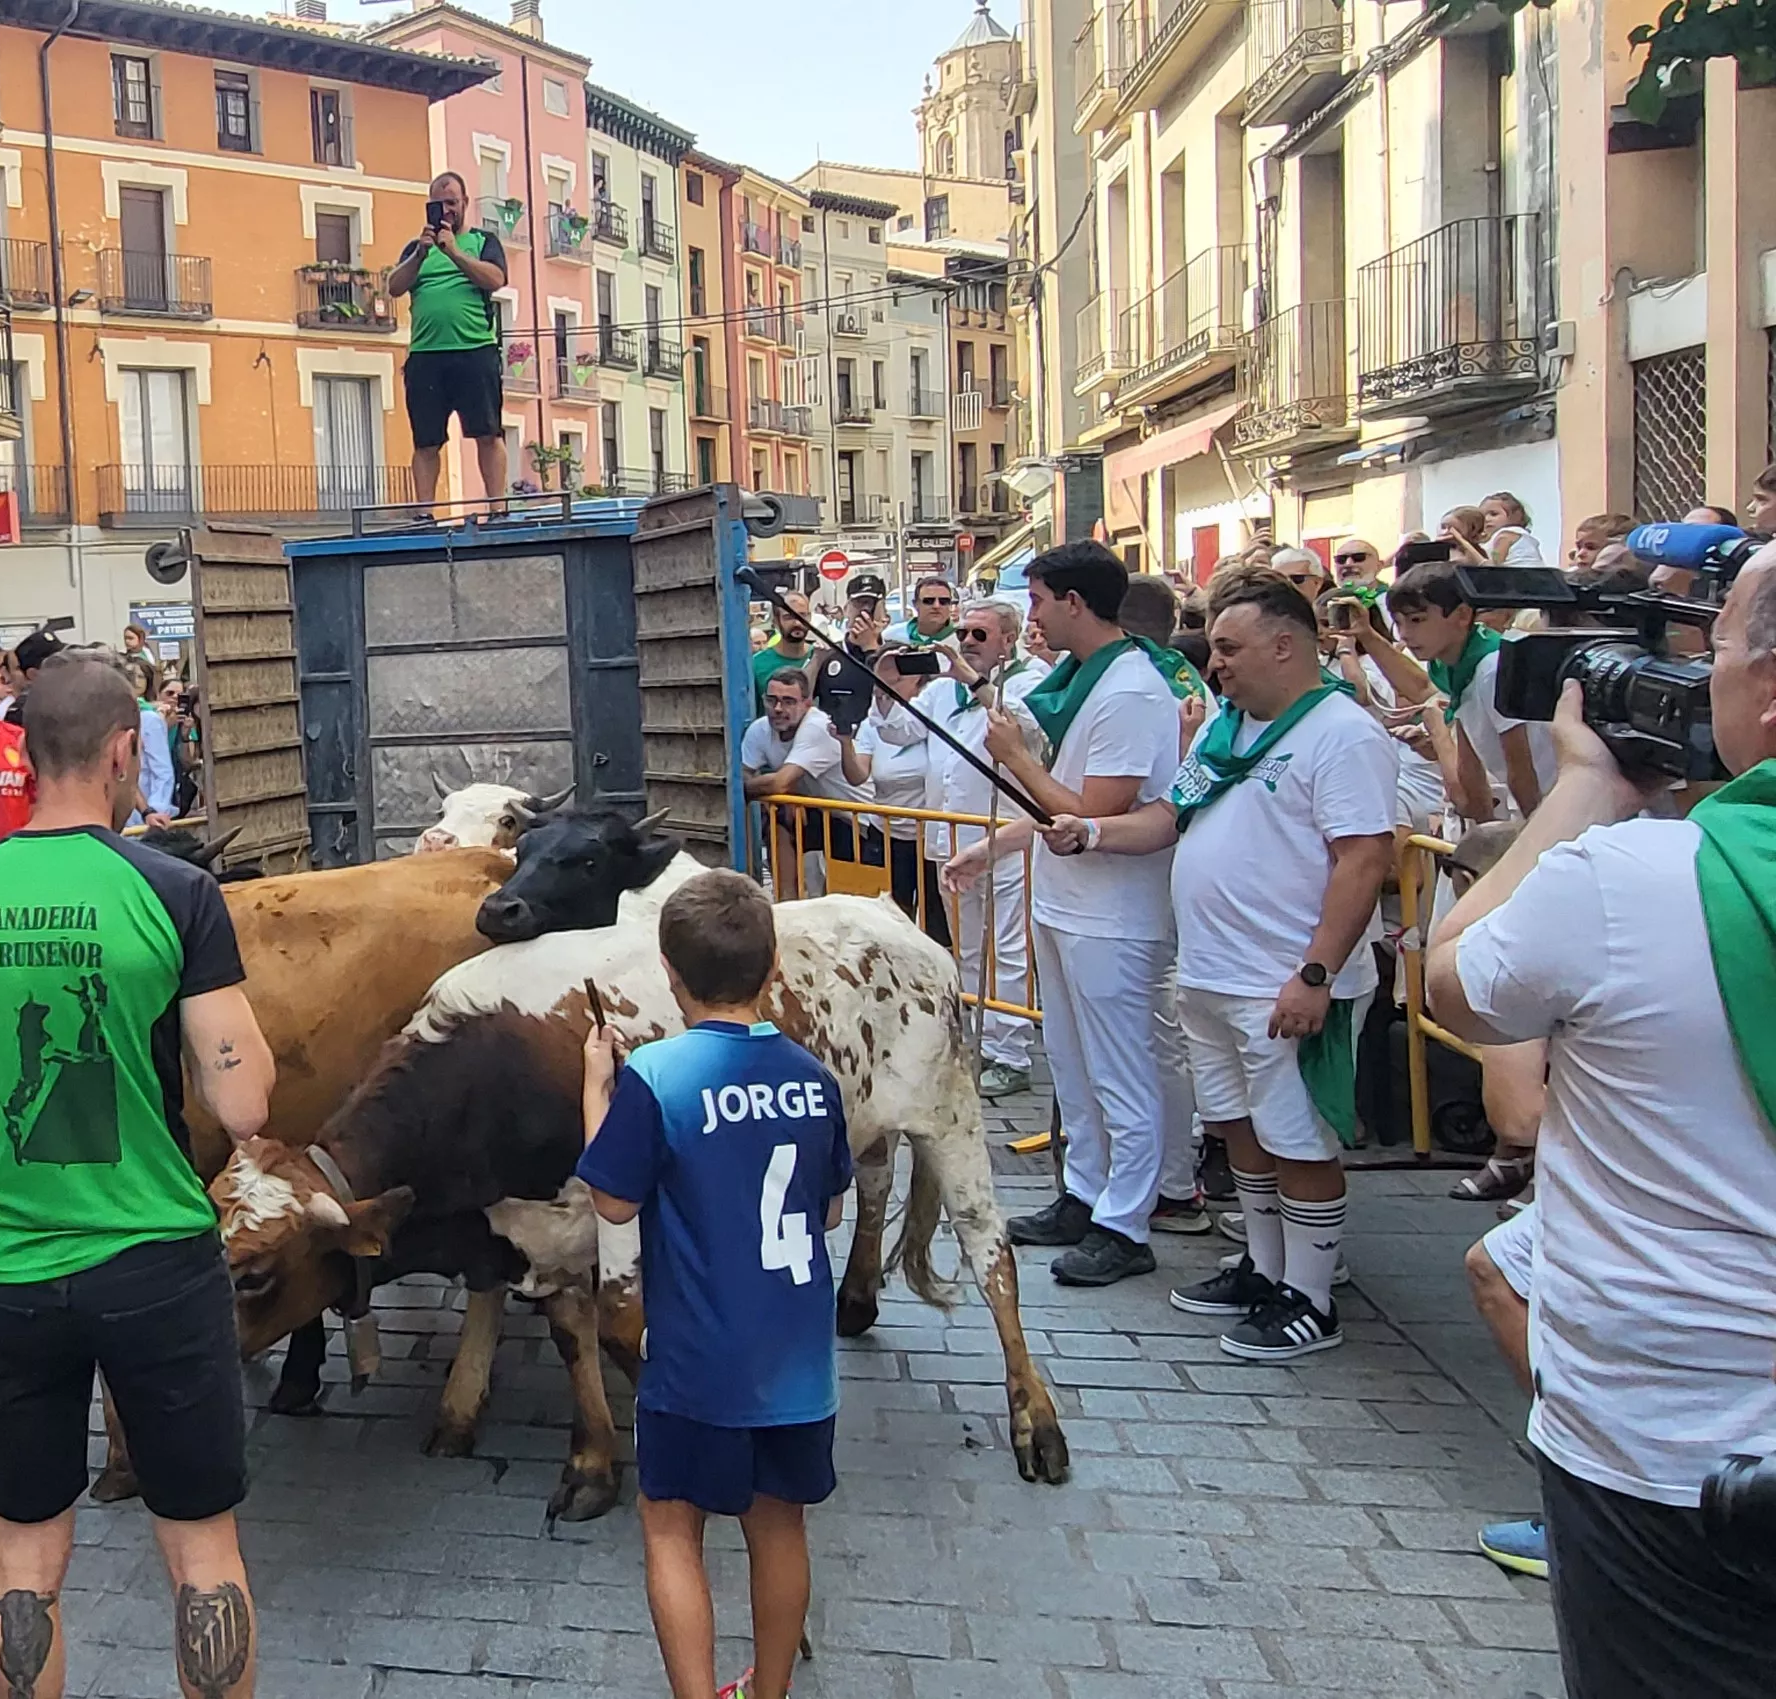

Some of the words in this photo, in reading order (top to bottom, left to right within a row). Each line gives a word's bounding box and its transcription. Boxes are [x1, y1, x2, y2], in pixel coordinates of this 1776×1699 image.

[1637, 524, 1669, 556] tve
[702, 1082, 827, 1134] JORGE
[761, 1143, 813, 1285] 4
